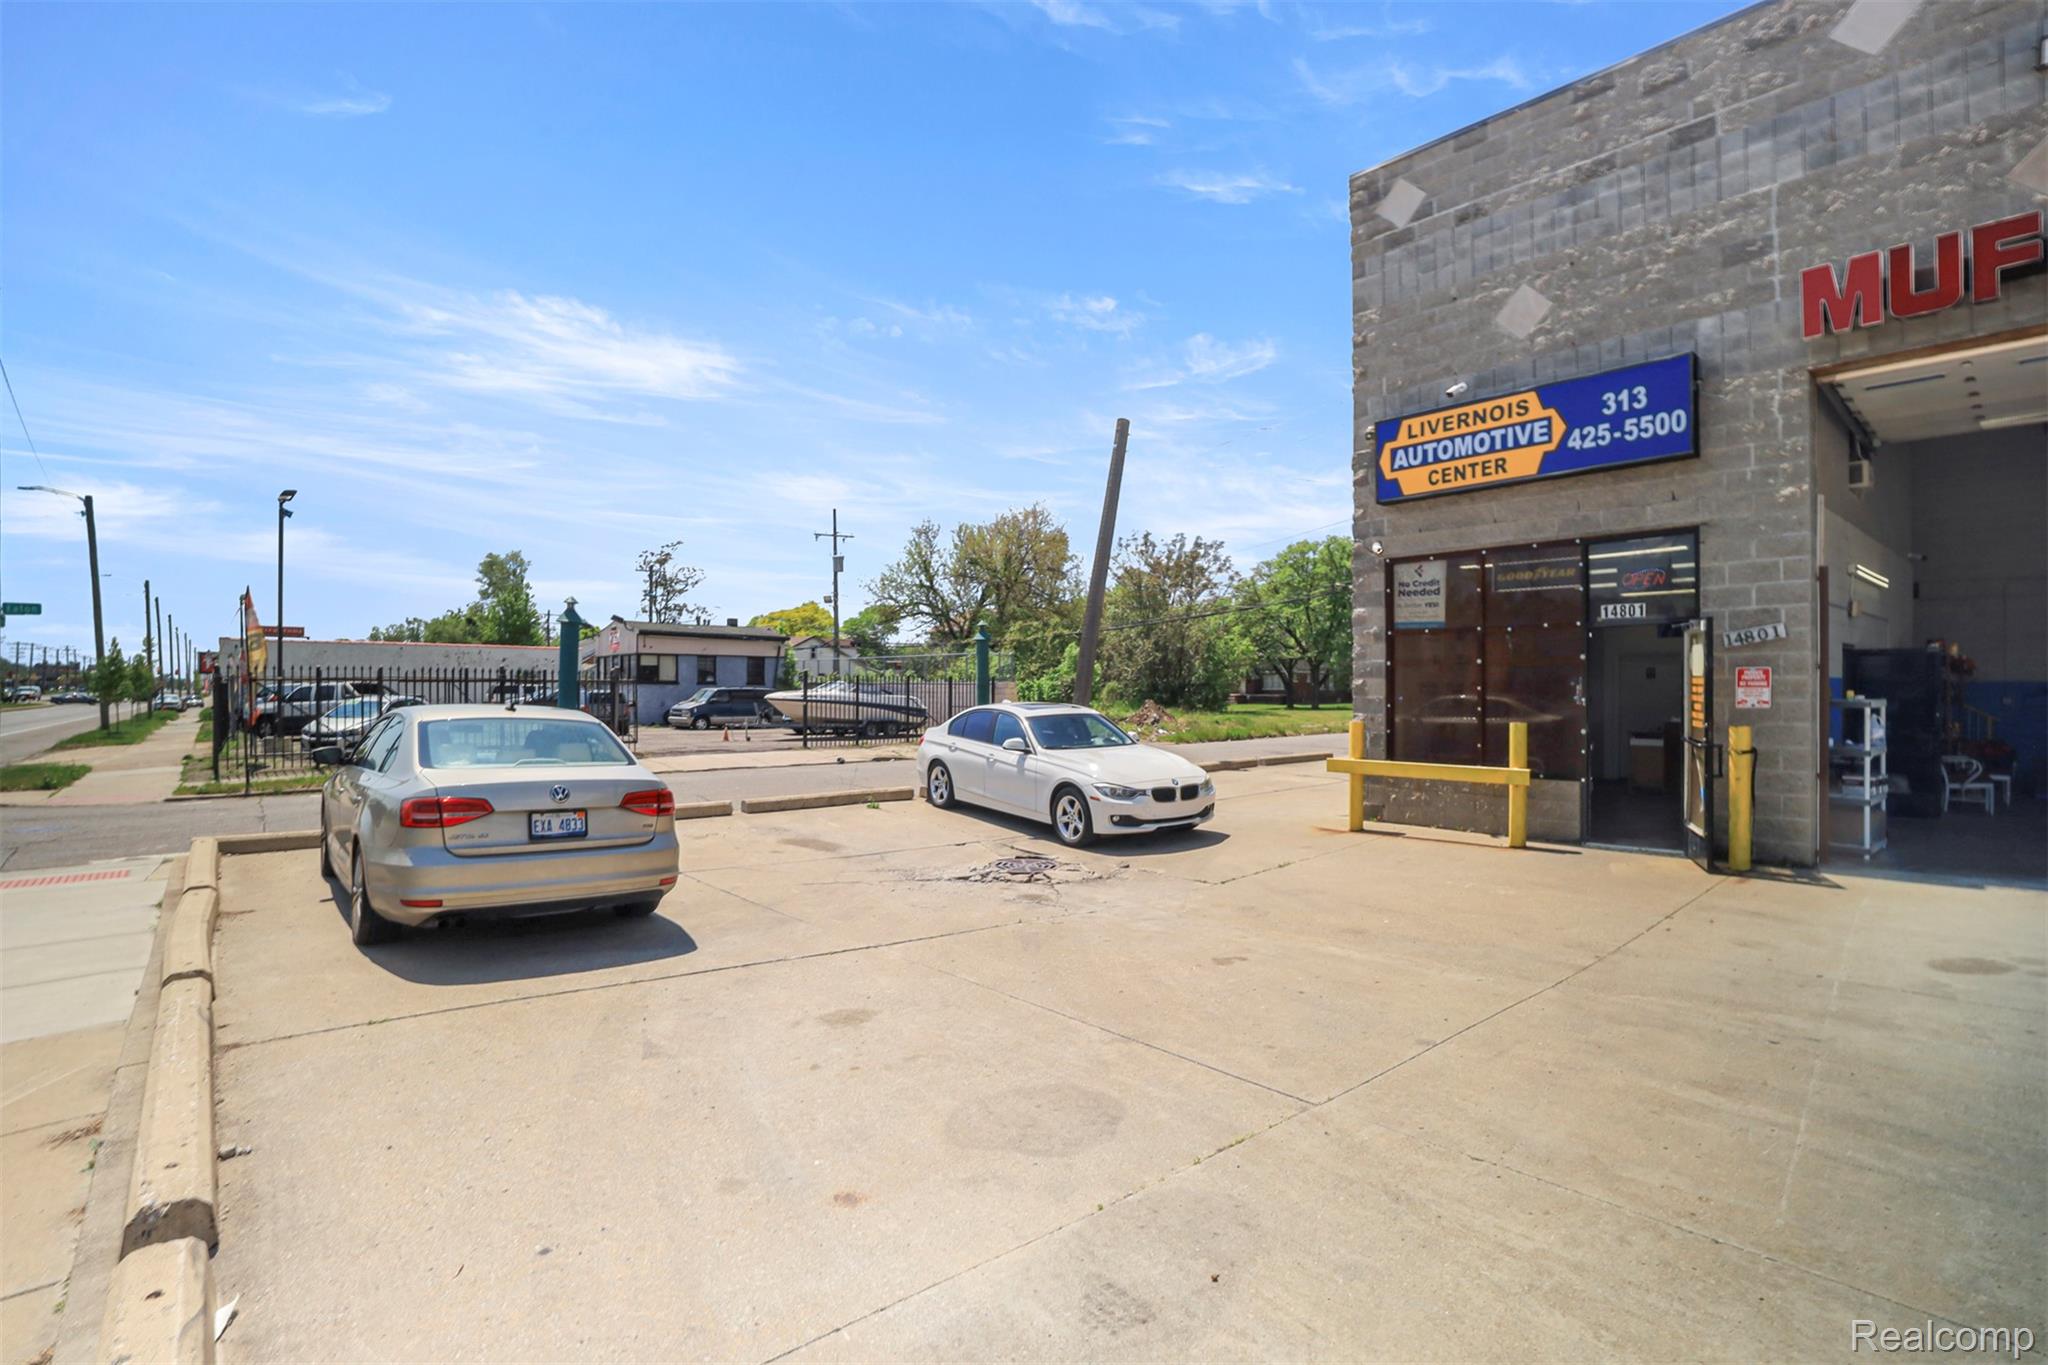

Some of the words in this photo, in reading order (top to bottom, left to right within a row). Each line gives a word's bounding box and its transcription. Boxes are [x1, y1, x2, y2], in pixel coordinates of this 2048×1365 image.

[1800, 210, 2043, 341] MUF
[1601, 385, 1648, 415] 313
[1407, 399, 1530, 439] LIVERNOIS
[1566, 408, 1687, 451] 425-5500
[1392, 419, 1550, 470] AUTOMOTIVE
[1427, 457, 1508, 486] CENTER
[1398, 581, 1410, 589] No
[1412, 579, 1440, 588] Credit
[1497, 566, 1577, 582] GOODYEAR
[1622, 573, 1666, 587] OPEN
[1398, 587, 1441, 597] Needed
[1602, 604, 1645, 618] 14801
[1725, 625, 1779, 646] 14801
[533, 819, 553, 834] EXA
[558, 817, 585, 833] 4833
